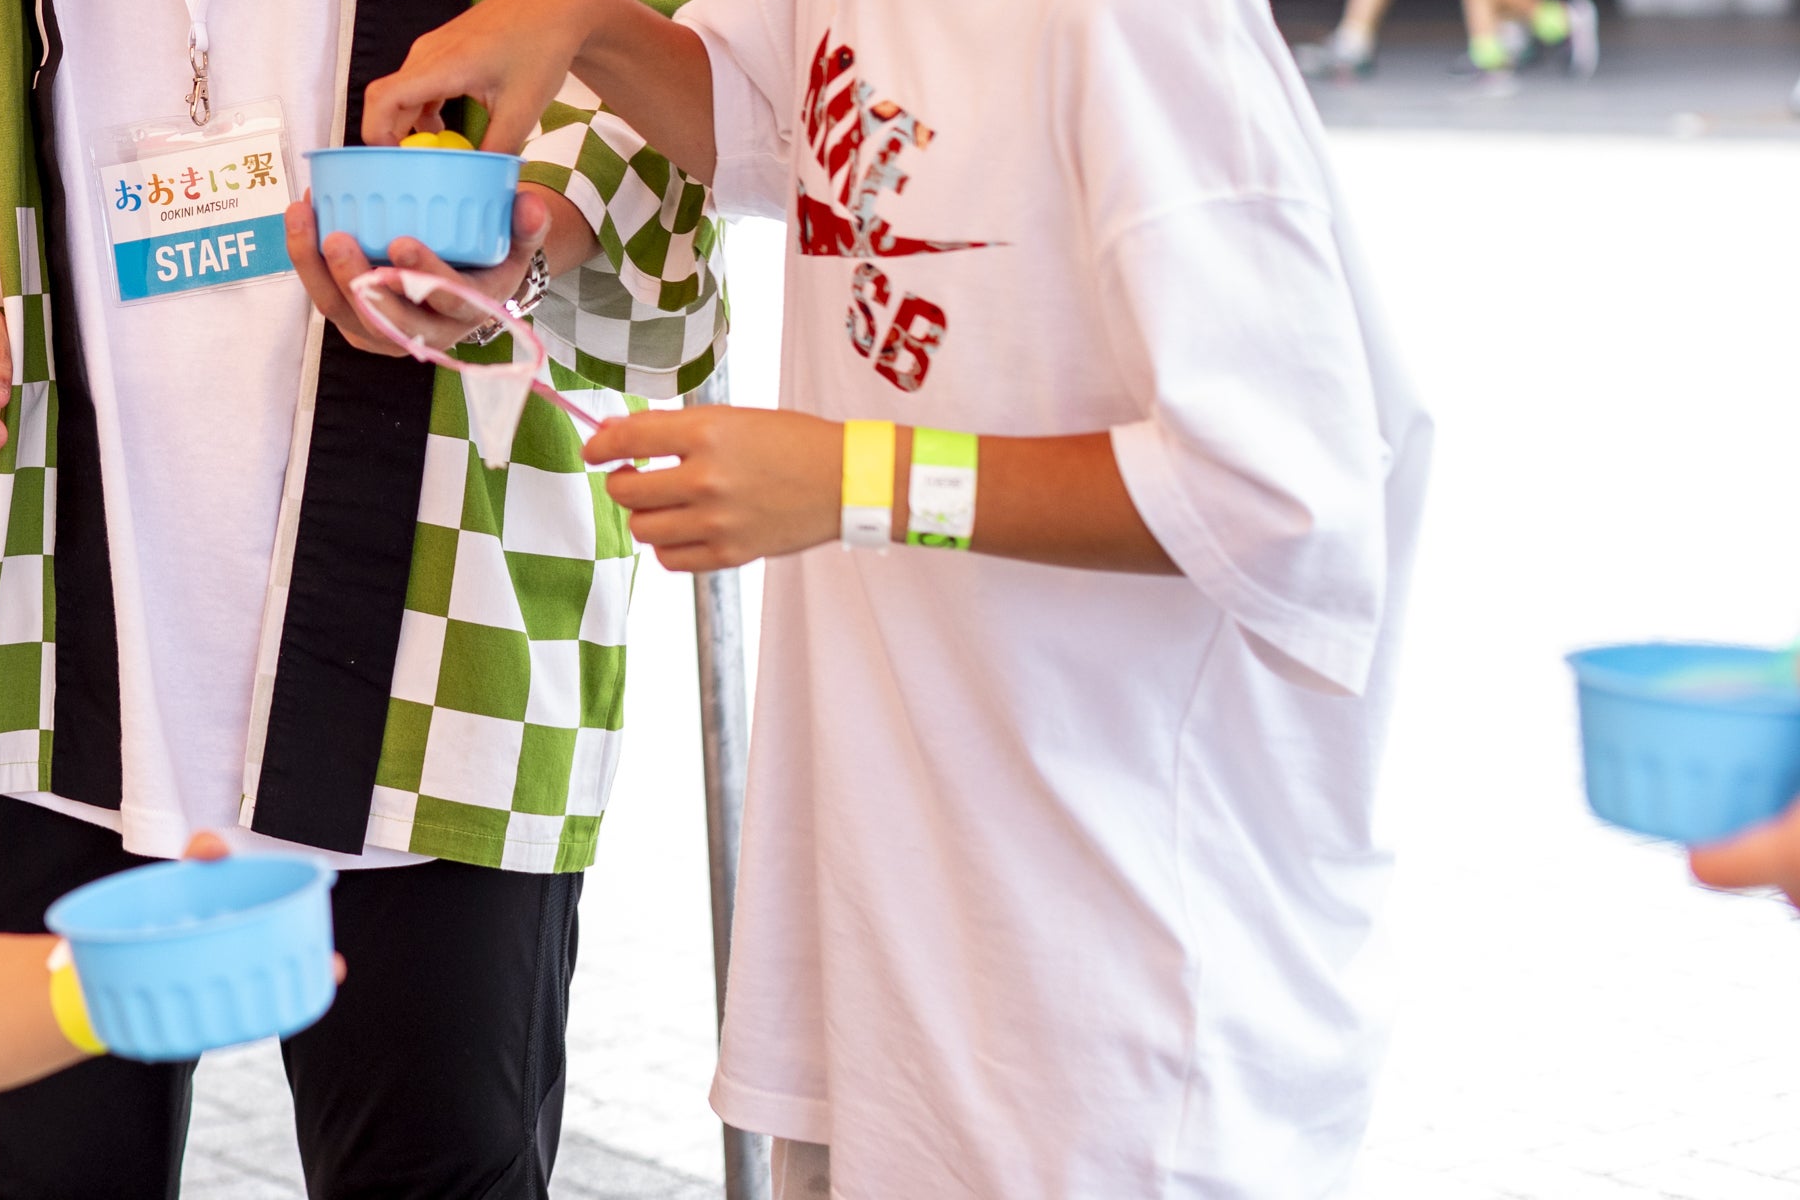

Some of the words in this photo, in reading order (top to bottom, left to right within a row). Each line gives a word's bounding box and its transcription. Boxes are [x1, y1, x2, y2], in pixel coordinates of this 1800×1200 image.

[114, 152, 278, 212] おおきに祭
[160, 205, 194, 222] OOKINI
[196, 198, 239, 215] MATSURI
[155, 230, 256, 282] STAFF
